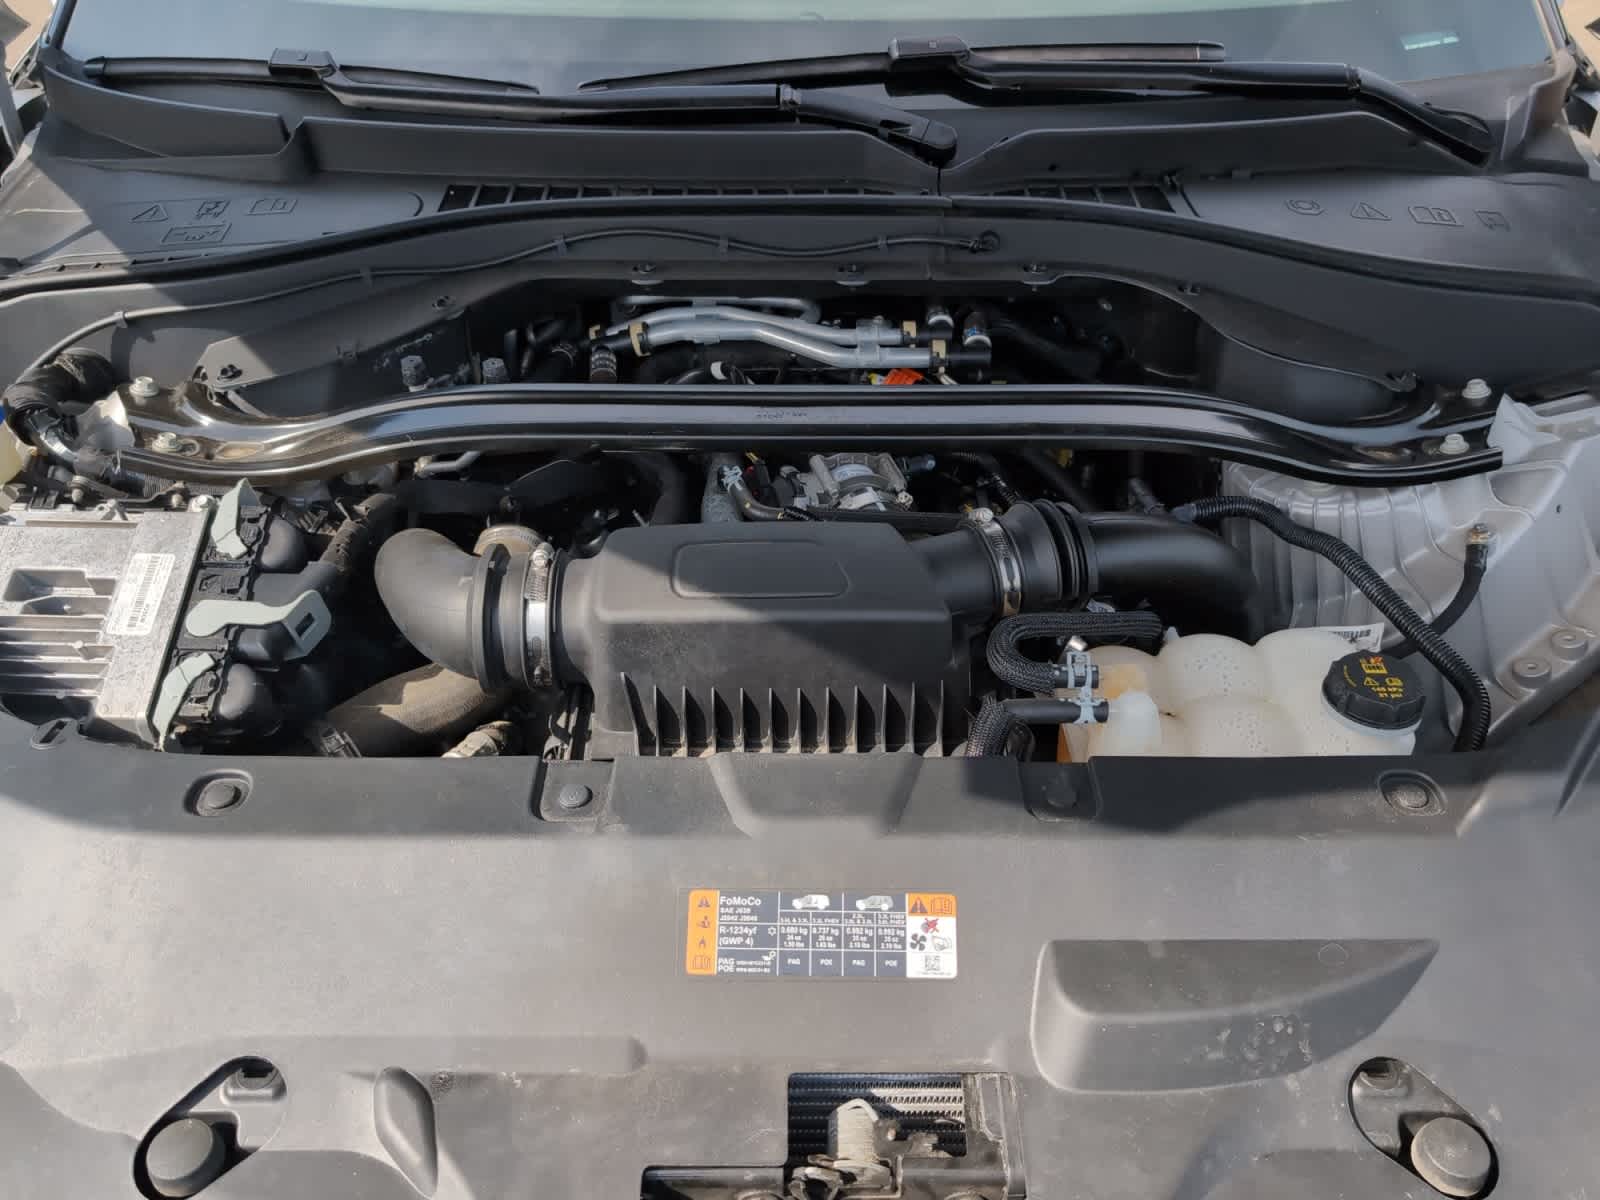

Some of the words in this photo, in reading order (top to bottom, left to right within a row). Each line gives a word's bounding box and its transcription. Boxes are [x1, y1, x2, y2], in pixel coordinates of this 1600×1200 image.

[720, 896, 762, 906] FoMoCo
[720, 926, 758, 936] R-1234yf
[800, 927, 808, 936] kg
[831, 928, 839, 936] kg
[864, 928, 873, 937] kg
[896, 929, 905, 937] kg
[719, 937, 743, 946] (GWP
[745, 937, 753, 947] 4)
[828, 941, 836, 949] lbs
[787, 958, 801, 966] PAG
[820, 958, 833, 966] POE
[852, 959, 866, 967] PAG
[885, 959, 898, 967] POE
